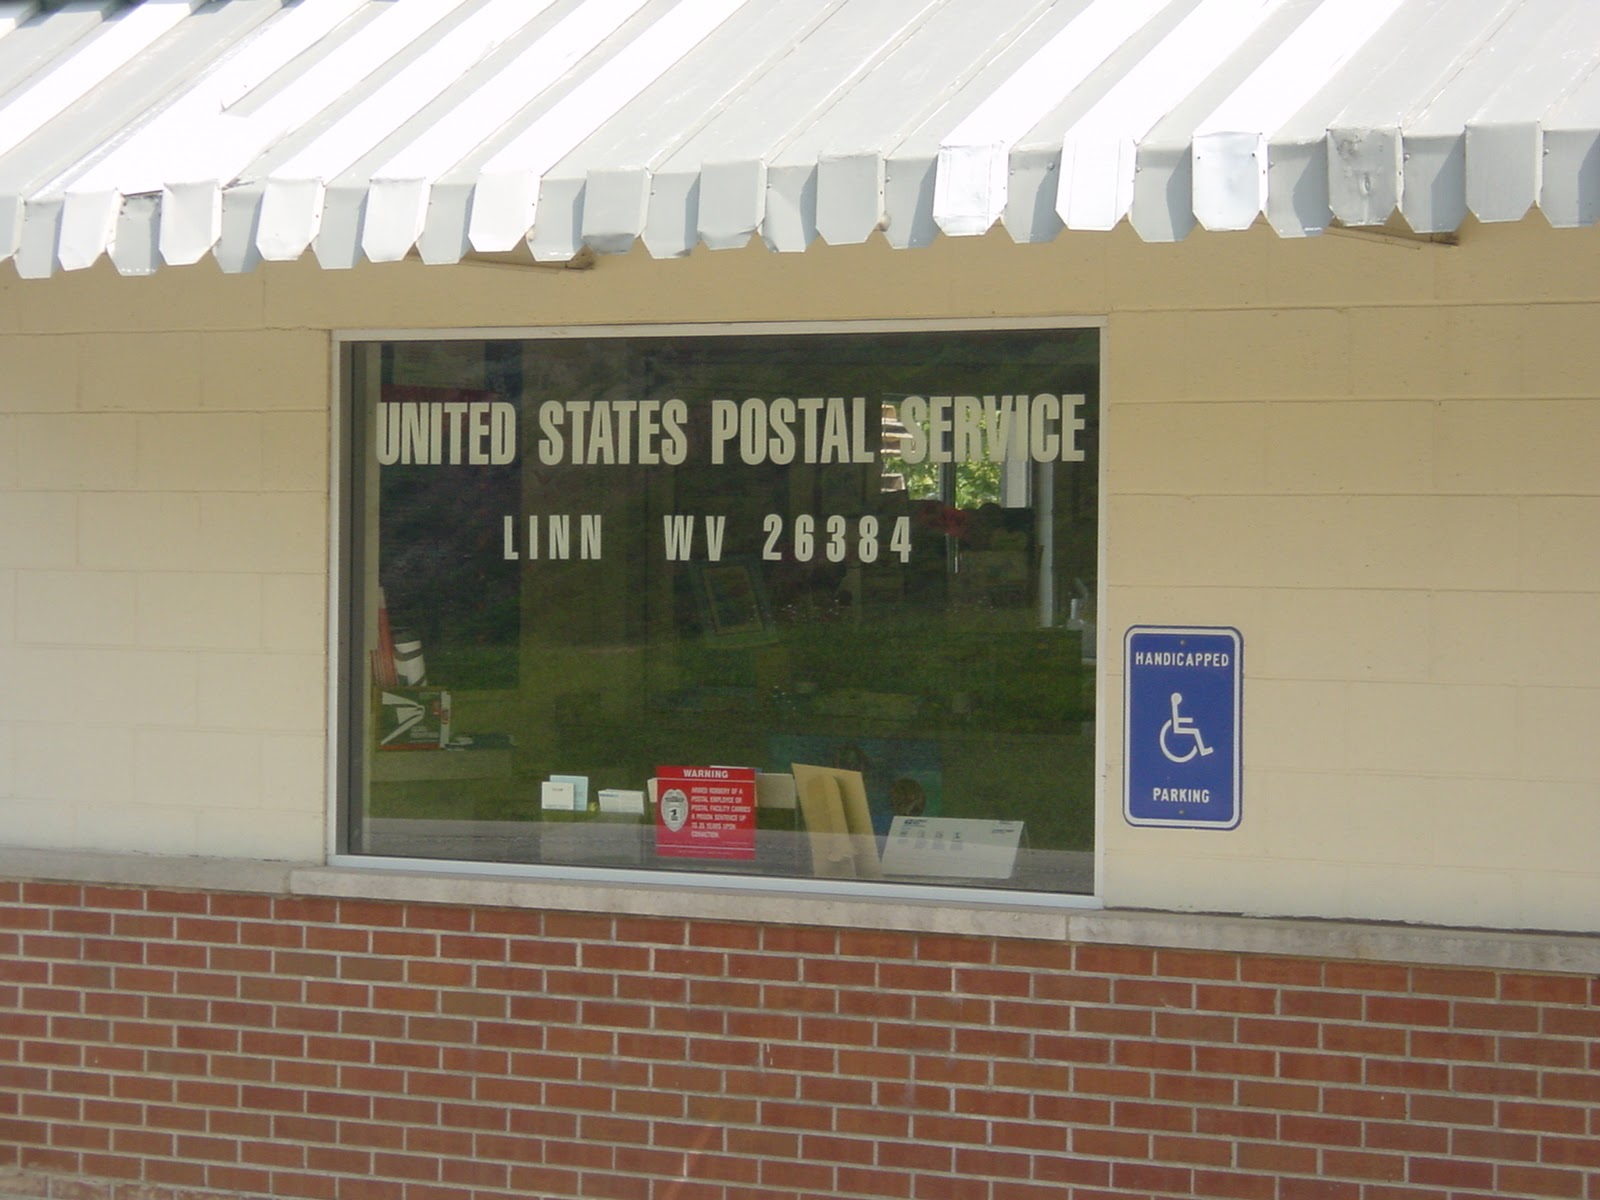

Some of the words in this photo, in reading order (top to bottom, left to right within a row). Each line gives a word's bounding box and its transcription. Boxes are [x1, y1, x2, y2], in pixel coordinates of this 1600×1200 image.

[375, 401, 516, 466] UNITED
[538, 399, 688, 466] STATES
[711, 397, 875, 465] POSTAL
[899, 393, 1085, 464] SERVICE
[503, 514, 602, 560] LINN
[663, 514, 726, 561] WV
[762, 513, 912, 563] 26384
[1135, 651, 1229, 667] HANDICAPPED
[683, 769, 728, 778] WARNING
[1153, 787, 1210, 804] PARKING
